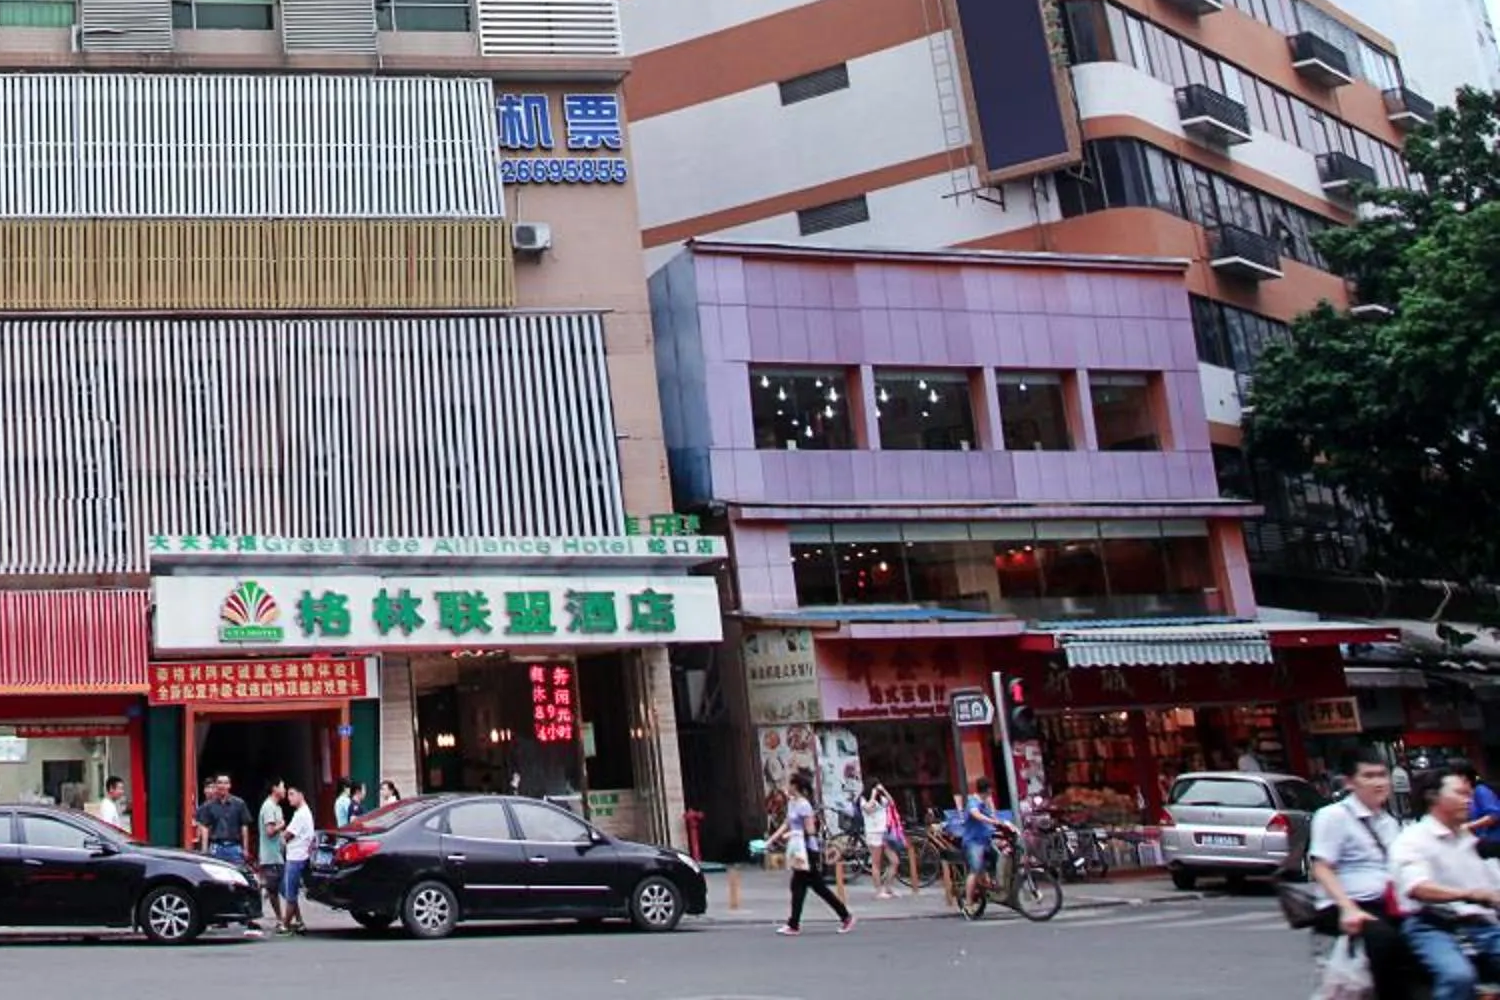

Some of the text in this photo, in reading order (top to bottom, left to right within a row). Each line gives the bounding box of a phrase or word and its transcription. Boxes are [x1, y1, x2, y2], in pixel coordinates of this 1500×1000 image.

[497, 94, 622, 149] 机票
[500, 159, 628, 184] 26695855
[434, 537, 551, 555] Alliance
[562, 537, 633, 555] Hotel
[647, 538, 714, 555] 蛇口店
[297, 587, 677, 636] 格林联盟酒店
